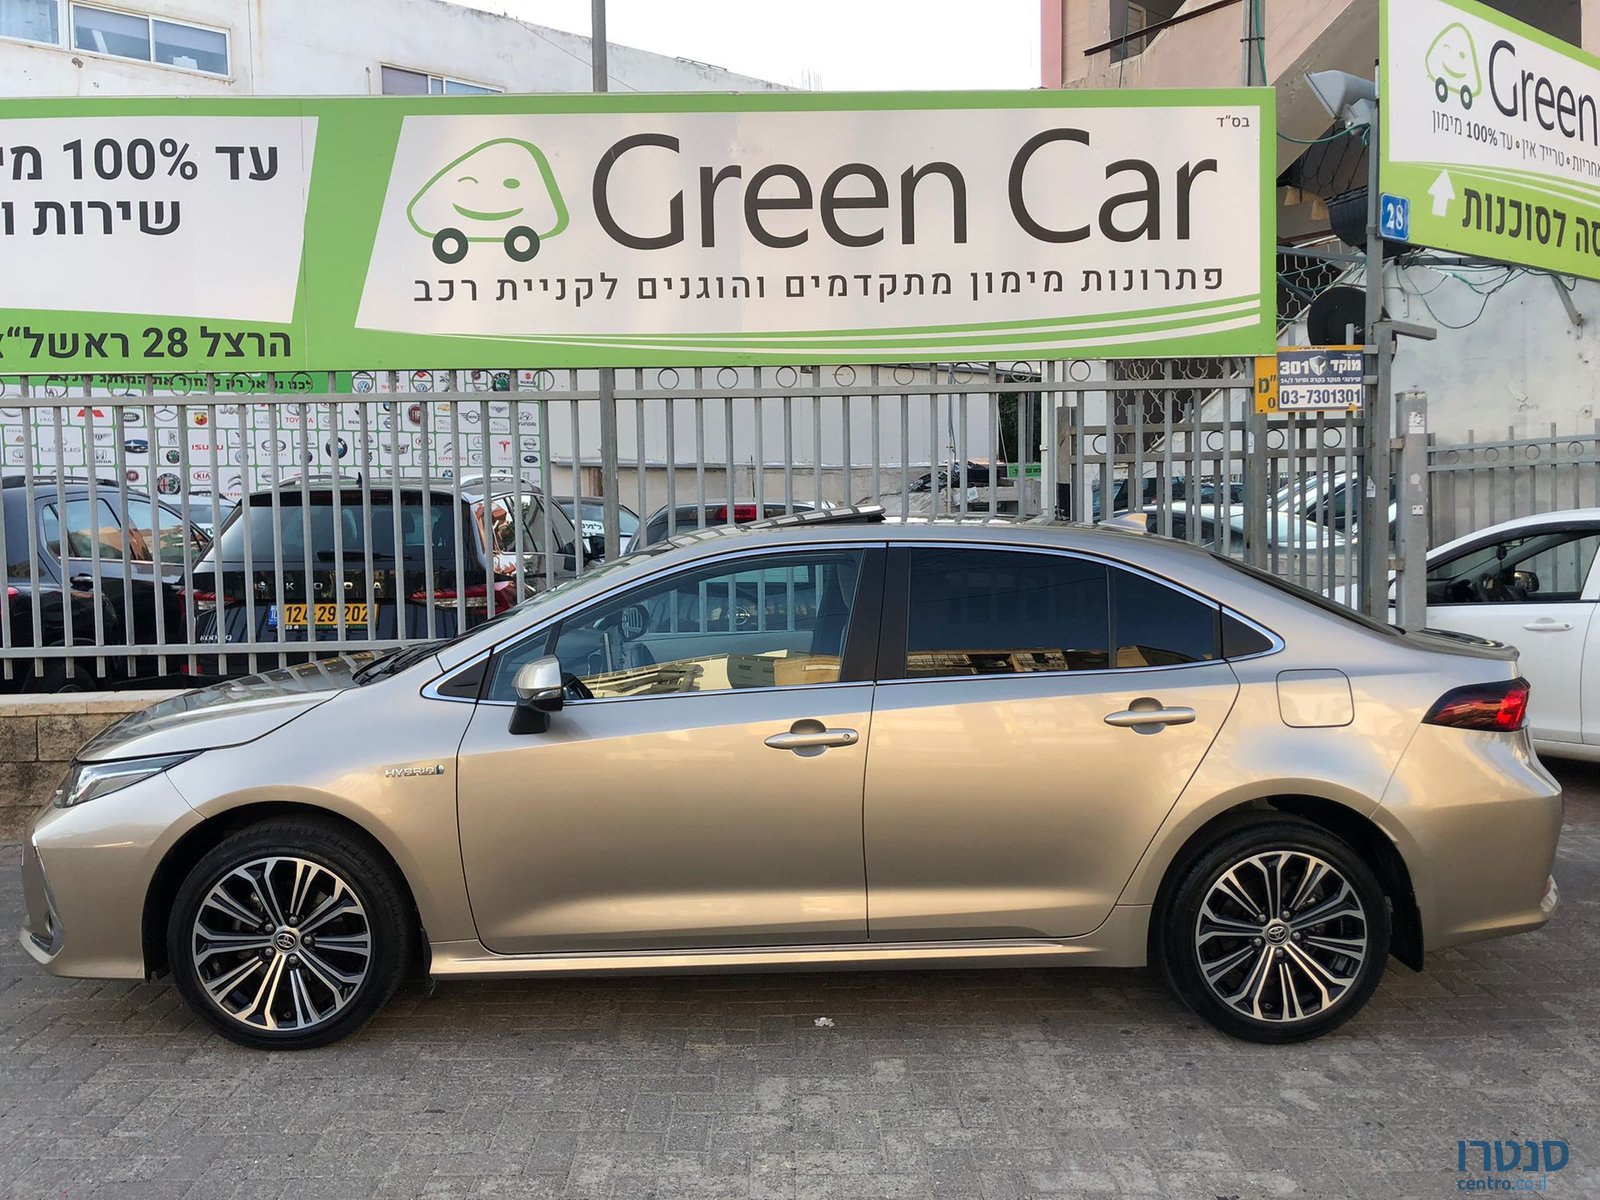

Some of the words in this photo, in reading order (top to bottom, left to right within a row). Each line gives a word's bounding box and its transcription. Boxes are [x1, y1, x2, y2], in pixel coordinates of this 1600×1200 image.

[1489, 39, 1598, 147] Green
[1432, 110, 1462, 135] מימון
[1467, 121, 1498, 146] 100%
[1500, 131, 1513, 151] עד
[1522, 138, 1536, 160] אין
[1539, 144, 1564, 167] טרייד
[63, 138, 198, 181] 100%
[216, 147, 277, 180] עד
[592, 133, 967, 251] Green
[1008, 127, 1217, 245] Car
[33, 201, 180, 235] שירות
[1386, 203, 1403, 231] 28
[1462, 187, 1566, 248] לסוכנות
[414, 279, 477, 302] רכב
[496, 272, 618, 308] לקניית
[638, 277, 764, 305] והוגנים
[786, 273, 952, 305] מתקדמים
[971, 271, 1063, 306] מימון
[1081, 269, 1222, 298] פתרונות
[143, 328, 189, 358] 28
[200, 326, 291, 358] הרצל
[1280, 361, 1309, 375] 301
[1281, 389, 1361, 404] 03-7301301
[385, 767, 434, 778] HYBRID
